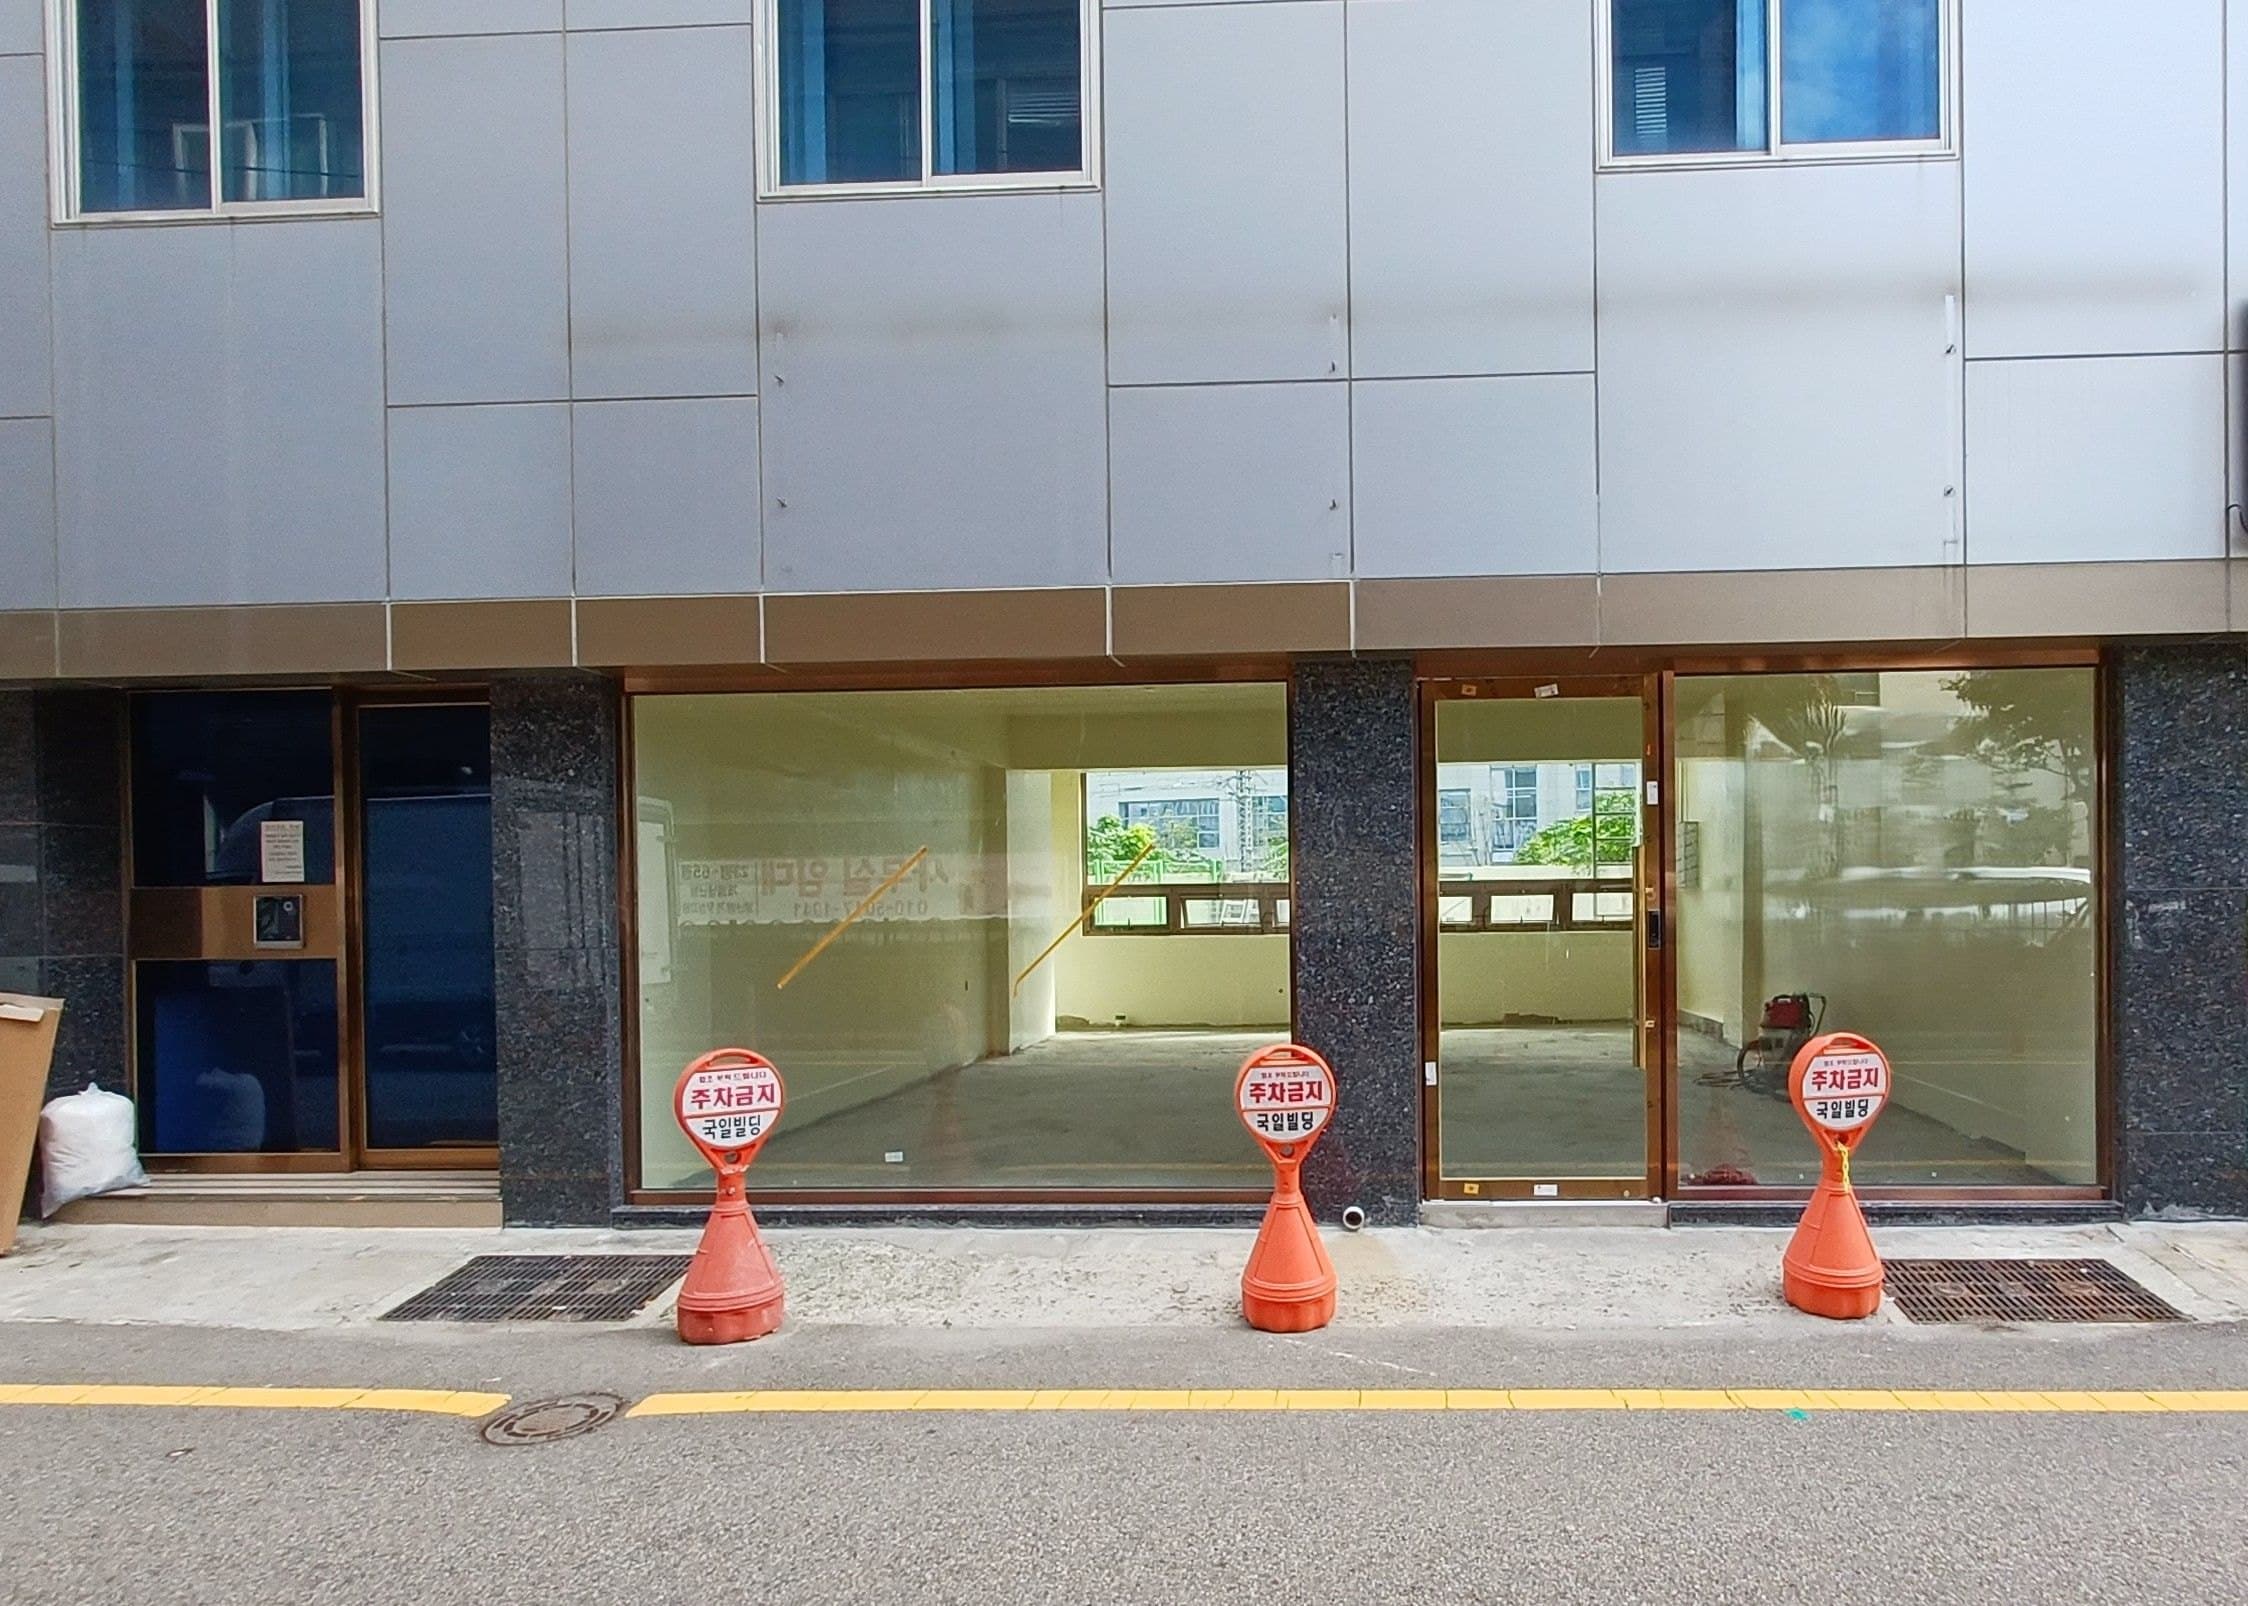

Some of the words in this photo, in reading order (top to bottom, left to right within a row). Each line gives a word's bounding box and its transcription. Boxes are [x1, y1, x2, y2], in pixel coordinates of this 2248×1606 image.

[1811, 1067, 1879, 1091] 주차금지
[691, 1082, 775, 1110] 주차금지
[1249, 1080, 1323, 1104] 주차금지
[1257, 1111, 1314, 1131] 국일빌딩
[1816, 1099, 1869, 1119] 국일빌딩
[702, 1115, 761, 1140] 국일빌딩
